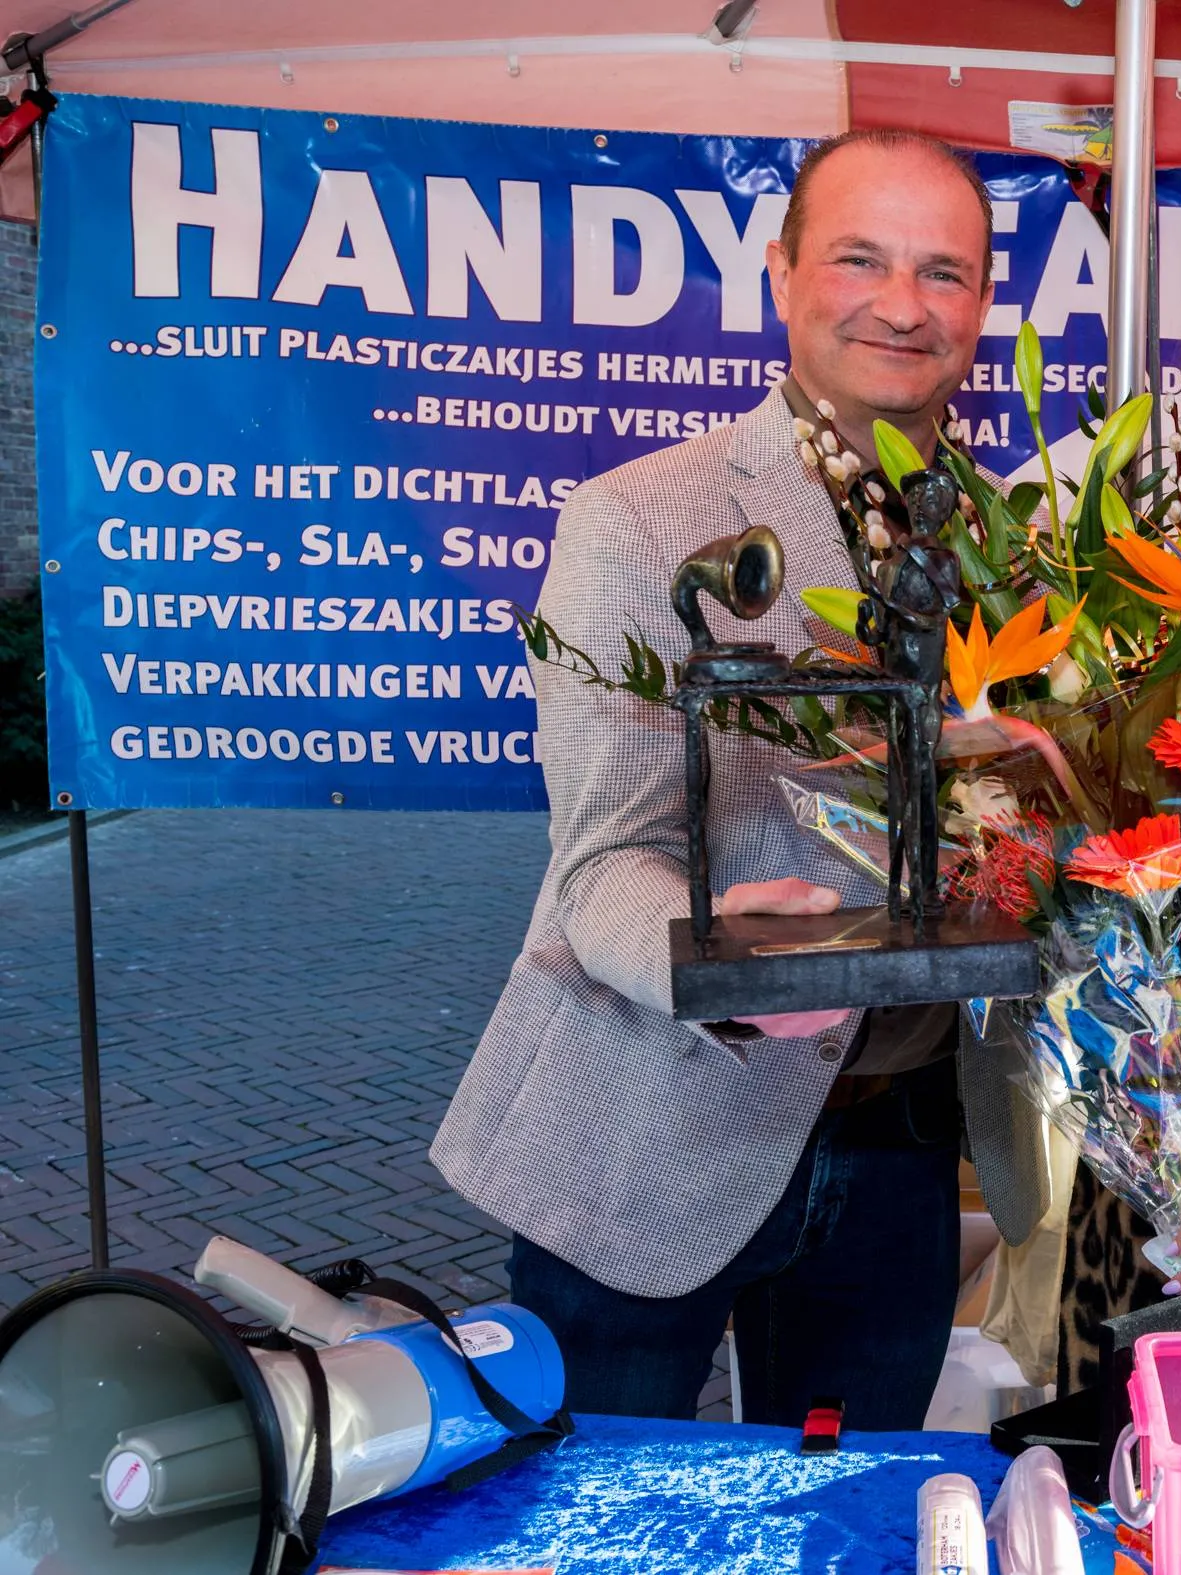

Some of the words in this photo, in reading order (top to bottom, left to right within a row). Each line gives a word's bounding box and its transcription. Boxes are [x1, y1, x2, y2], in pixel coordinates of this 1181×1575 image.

[280, 328, 583, 384] PLASTICZAKJES
[597, 352, 787, 388] HERMETIS
[608, 407, 748, 438] VERSH
[91, 449, 236, 494] VOOR
[254, 464, 339, 499] HET
[353, 465, 578, 510] DICHTLAS
[97, 517, 281, 572] CHIPS-,
[300, 524, 423, 573] SLA-,
[441, 526, 557, 568] SNO
[101, 652, 461, 699] VERPAKKINGEN
[476, 664, 536, 699] VA
[110, 725, 394, 764] GEDROOGDE
